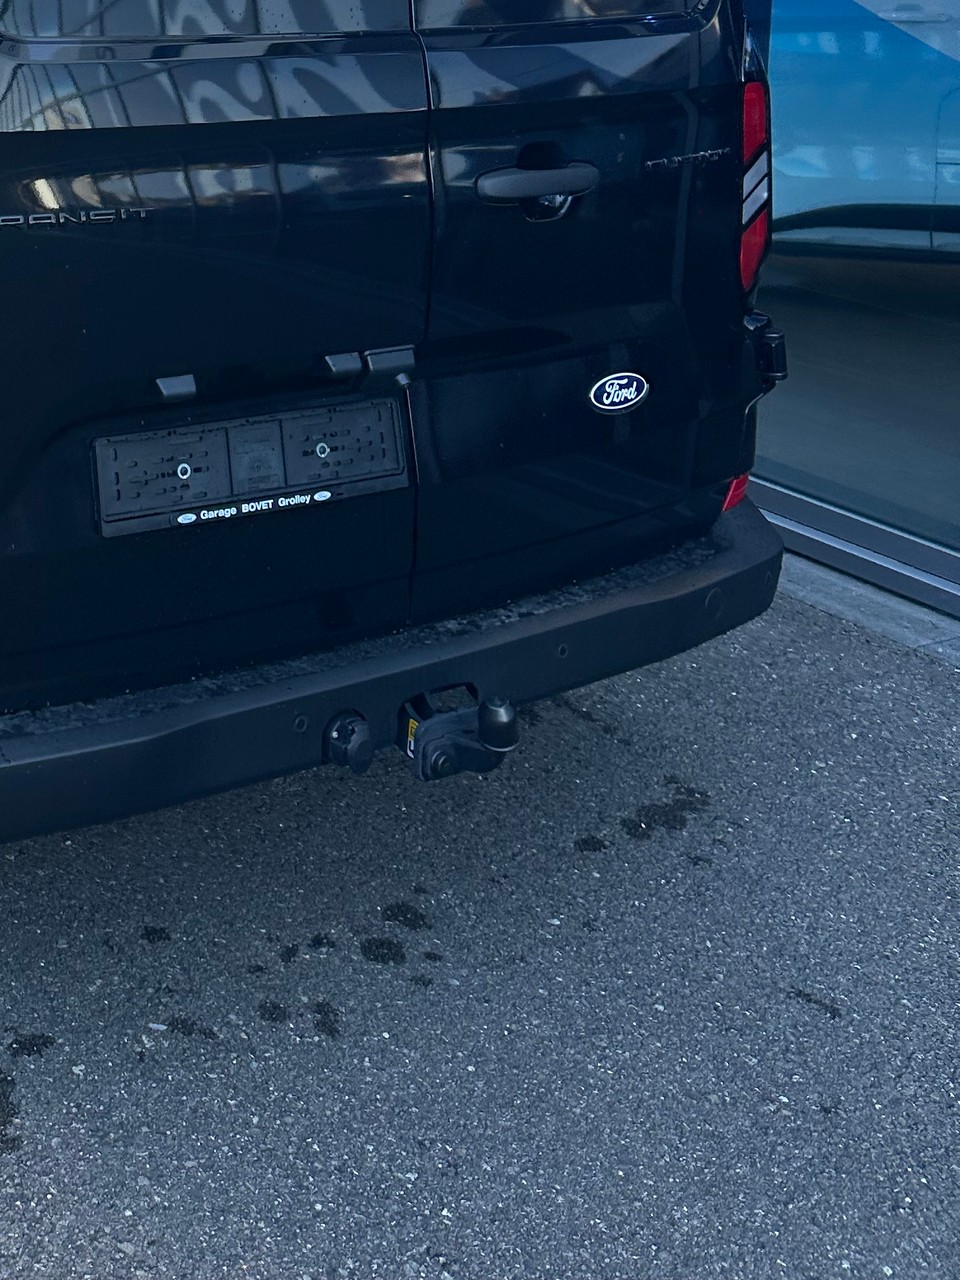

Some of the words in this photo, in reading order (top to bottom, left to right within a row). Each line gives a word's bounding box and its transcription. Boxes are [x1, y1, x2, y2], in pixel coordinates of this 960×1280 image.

[603, 378, 637, 404] Ford
[200, 505, 237, 520] Garage
[241, 499, 274, 514] BOVET
[278, 493, 311, 508] Grolley
